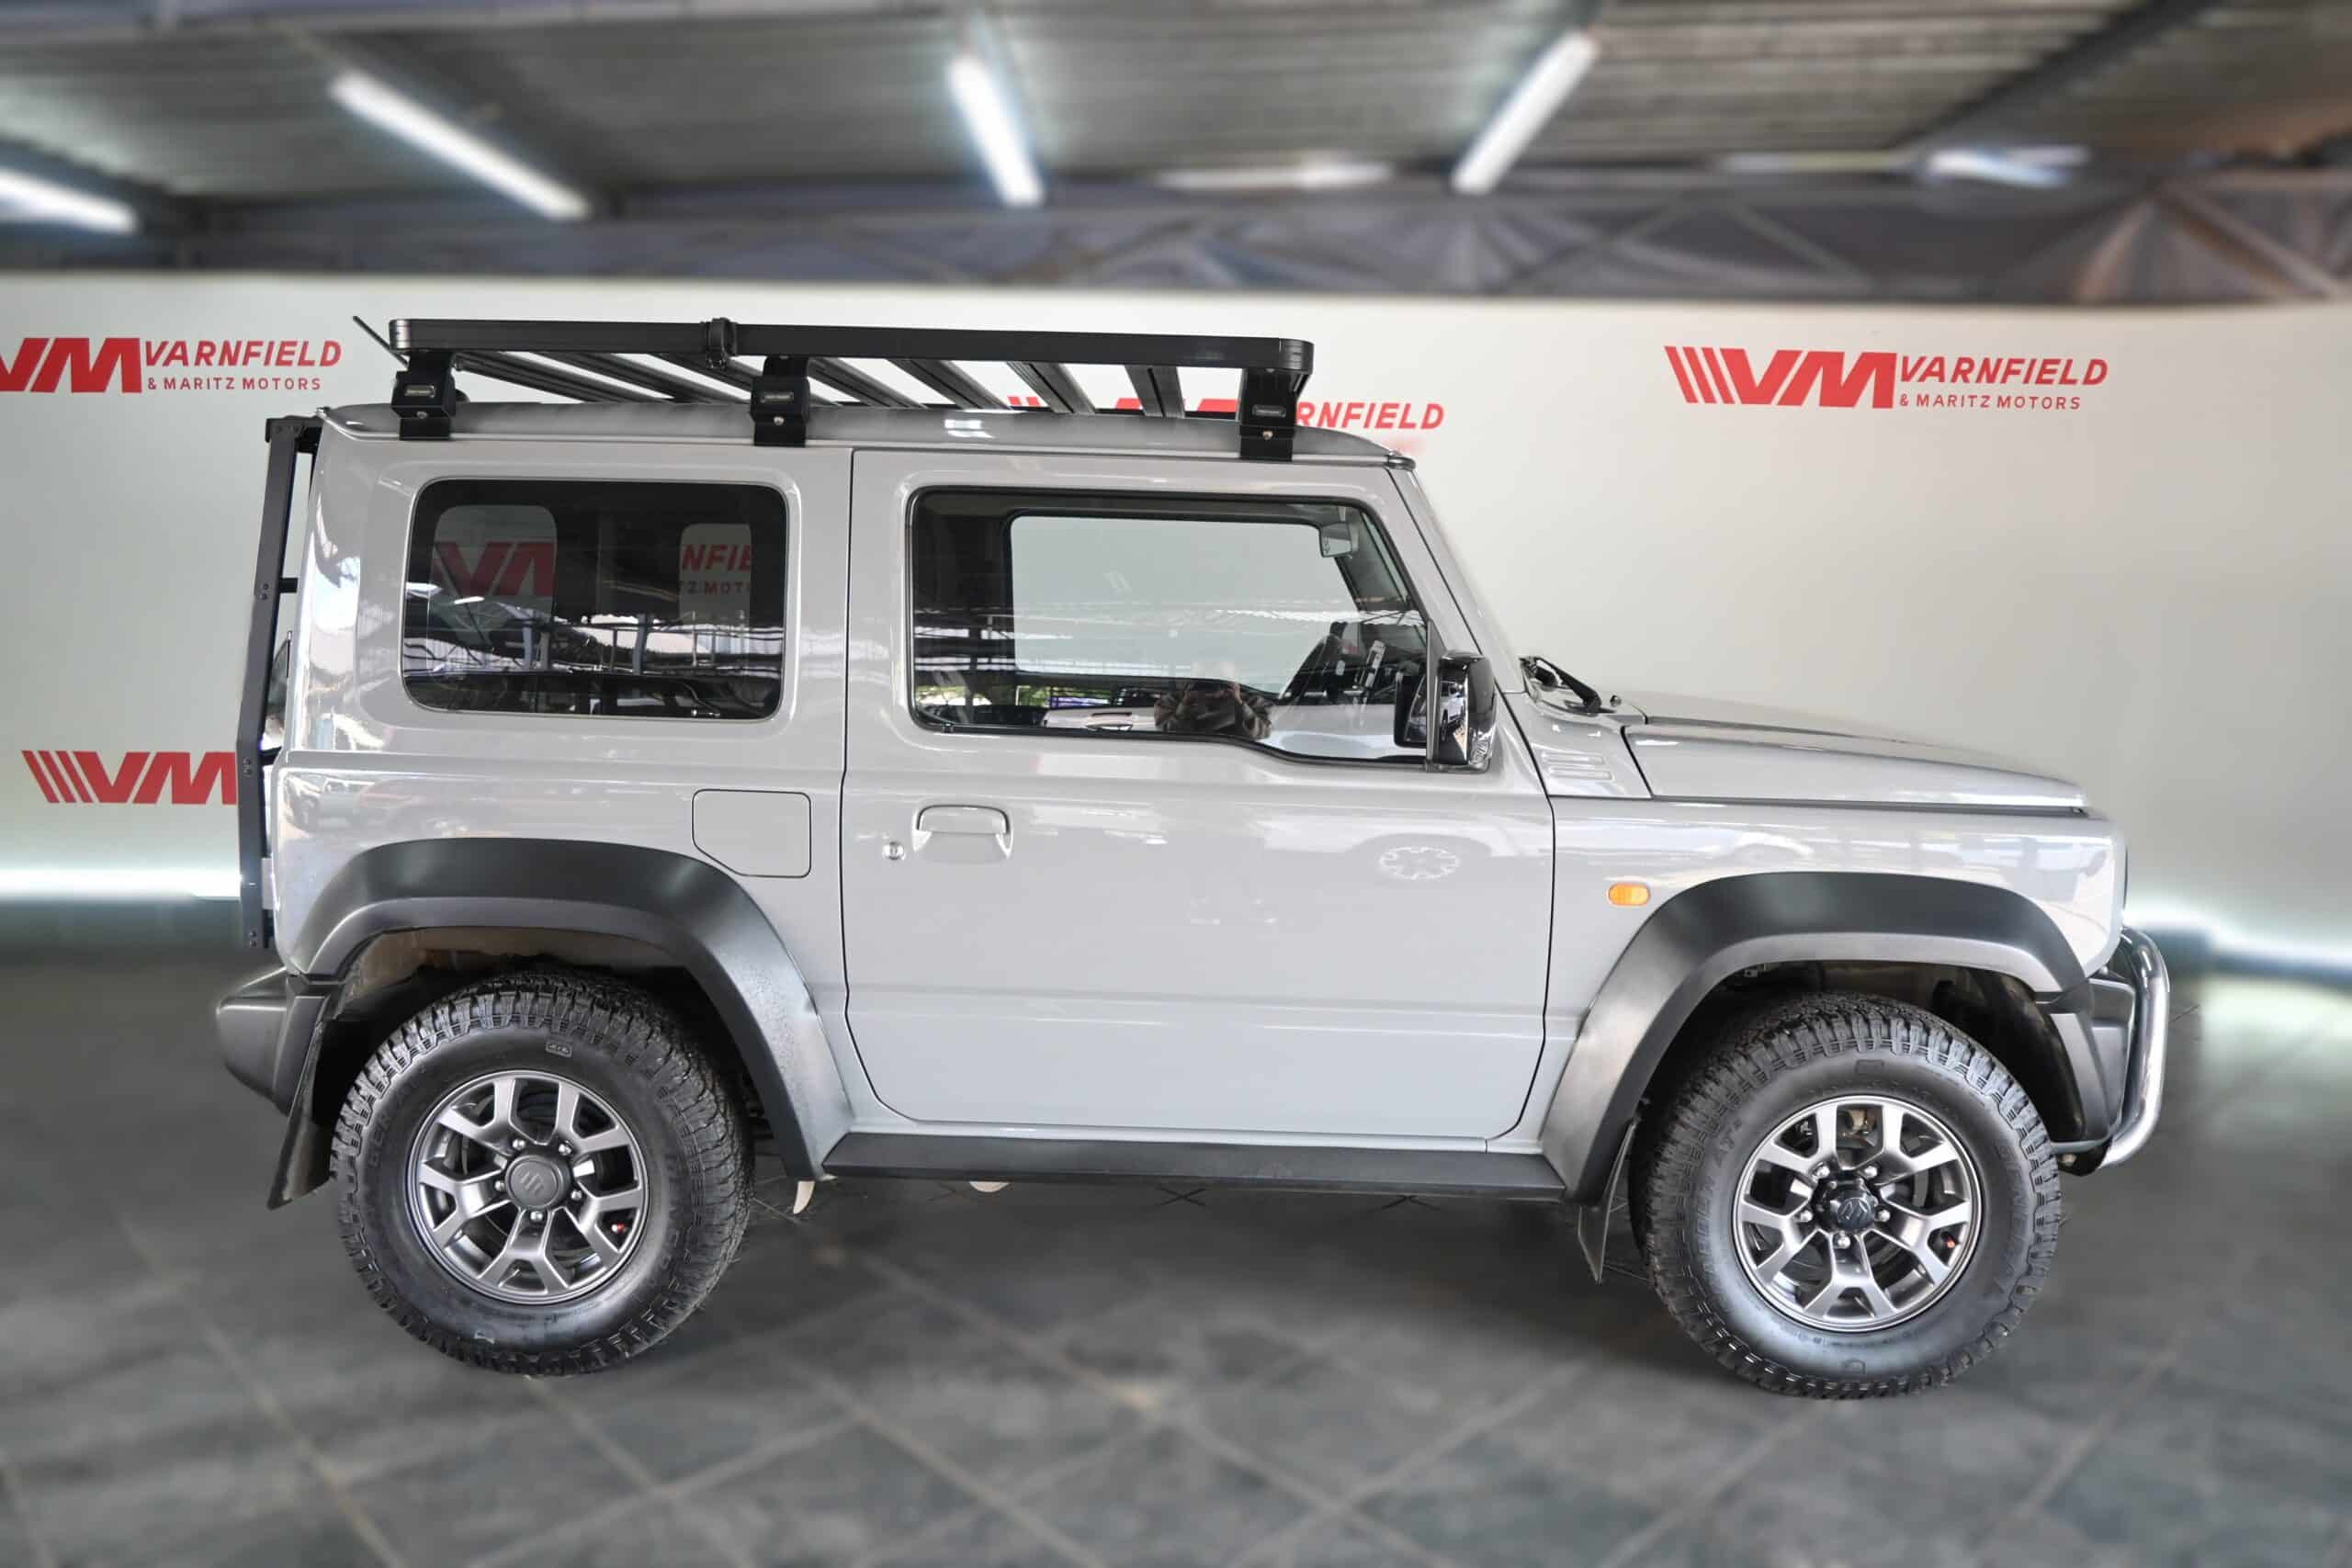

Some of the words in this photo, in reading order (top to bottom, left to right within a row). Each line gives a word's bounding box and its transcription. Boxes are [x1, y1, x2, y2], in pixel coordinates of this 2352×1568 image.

[144, 340, 343, 367] VARNFIELD
[147, 377, 157, 390] &
[164, 377, 235, 390] MARITZ
[242, 377, 322, 390] MOTORS
[1901, 355, 2109, 386] VARNFIELD
[1296, 401, 1445, 430] RNFIELD
[1899, 393, 1909, 407] &
[1916, 394, 1991, 409] MARITZ
[1996, 395, 2081, 411] MOTORS
